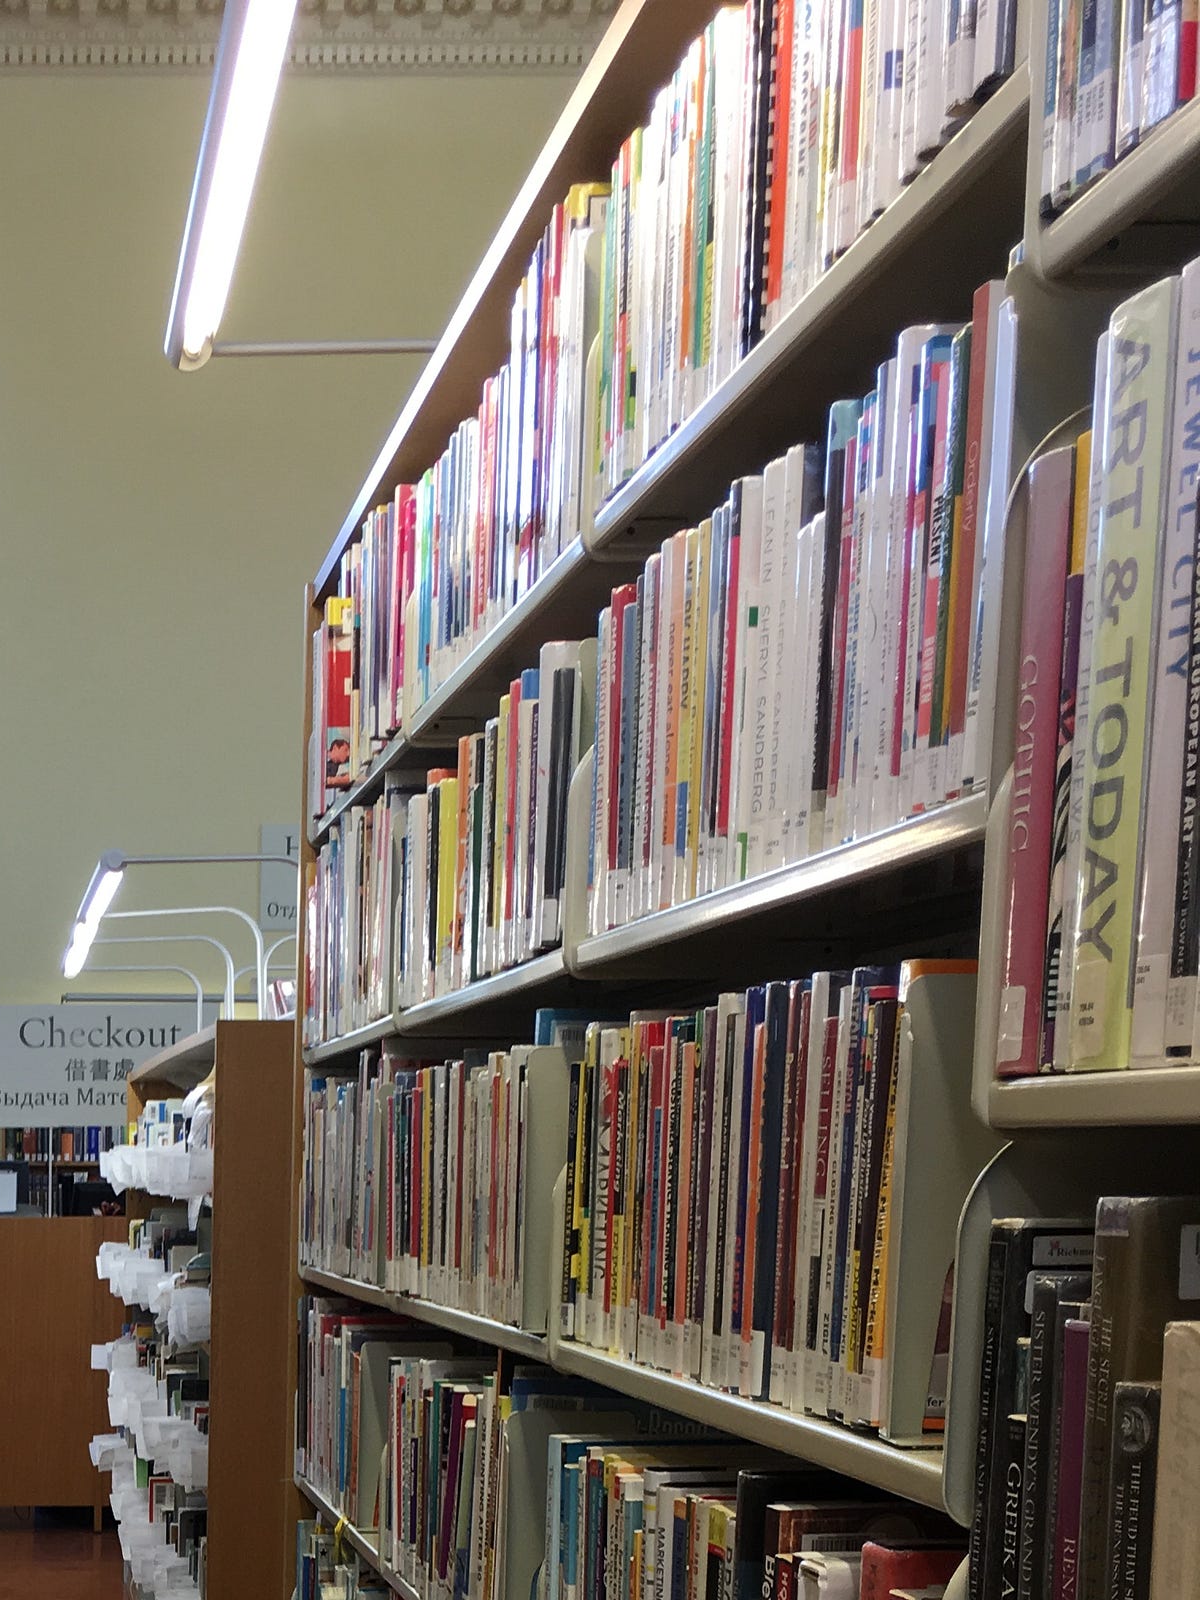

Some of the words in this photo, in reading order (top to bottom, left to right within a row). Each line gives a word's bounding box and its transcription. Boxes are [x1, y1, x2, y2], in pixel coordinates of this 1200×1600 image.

[1106, 339, 1151, 529] ART
[963, 440, 978, 531] Orderly
[1089, 460, 1102, 577] SHOCK
[764, 496, 775, 555] LEAN
[930, 496, 943, 567] PRESENT
[1101, 557, 1138, 625] &
[1166, 555, 1194, 680] CITY
[758, 605, 770, 684] SHERYL
[848, 639, 857, 732] BUSINESS
[1078, 668, 1091, 725] THE
[1186, 653, 1199, 788] EUROPEAN
[665, 723, 674, 776] alone
[752, 696, 766, 813] SANDBERG
[1013, 654, 1038, 853] GOTHIC
[1071, 750, 1085, 844] NEWS
[1078, 636, 1133, 962] TODAY
[1182, 796, 1194, 845] ART
[18, 1015, 182, 1049] Checkout
[64, 1057, 135, 1083] 借書處
[869, 1028, 878, 1099] Marketing
[615, 1091, 625, 1192] Marketing
[780, 1052, 794, 1169] Brandwashed
[816, 1056, 831, 1177] SELLING
[1033, 1311, 1045, 1384] SISTER
[1102, 1317, 1112, 1354] THE
[1097, 1357, 1109, 1424] SECRET
[1027, 1391, 1040, 1491] WENDY'S
[1131, 1462, 1142, 1495] THE
[1003, 1462, 1021, 1567] GREEK
[1116, 1484, 1125, 1513] THE
[1128, 1498, 1139, 1539] FEUD
[1023, 1499, 1034, 1581] GRAND
[1125, 1543, 1136, 1583] THAT
